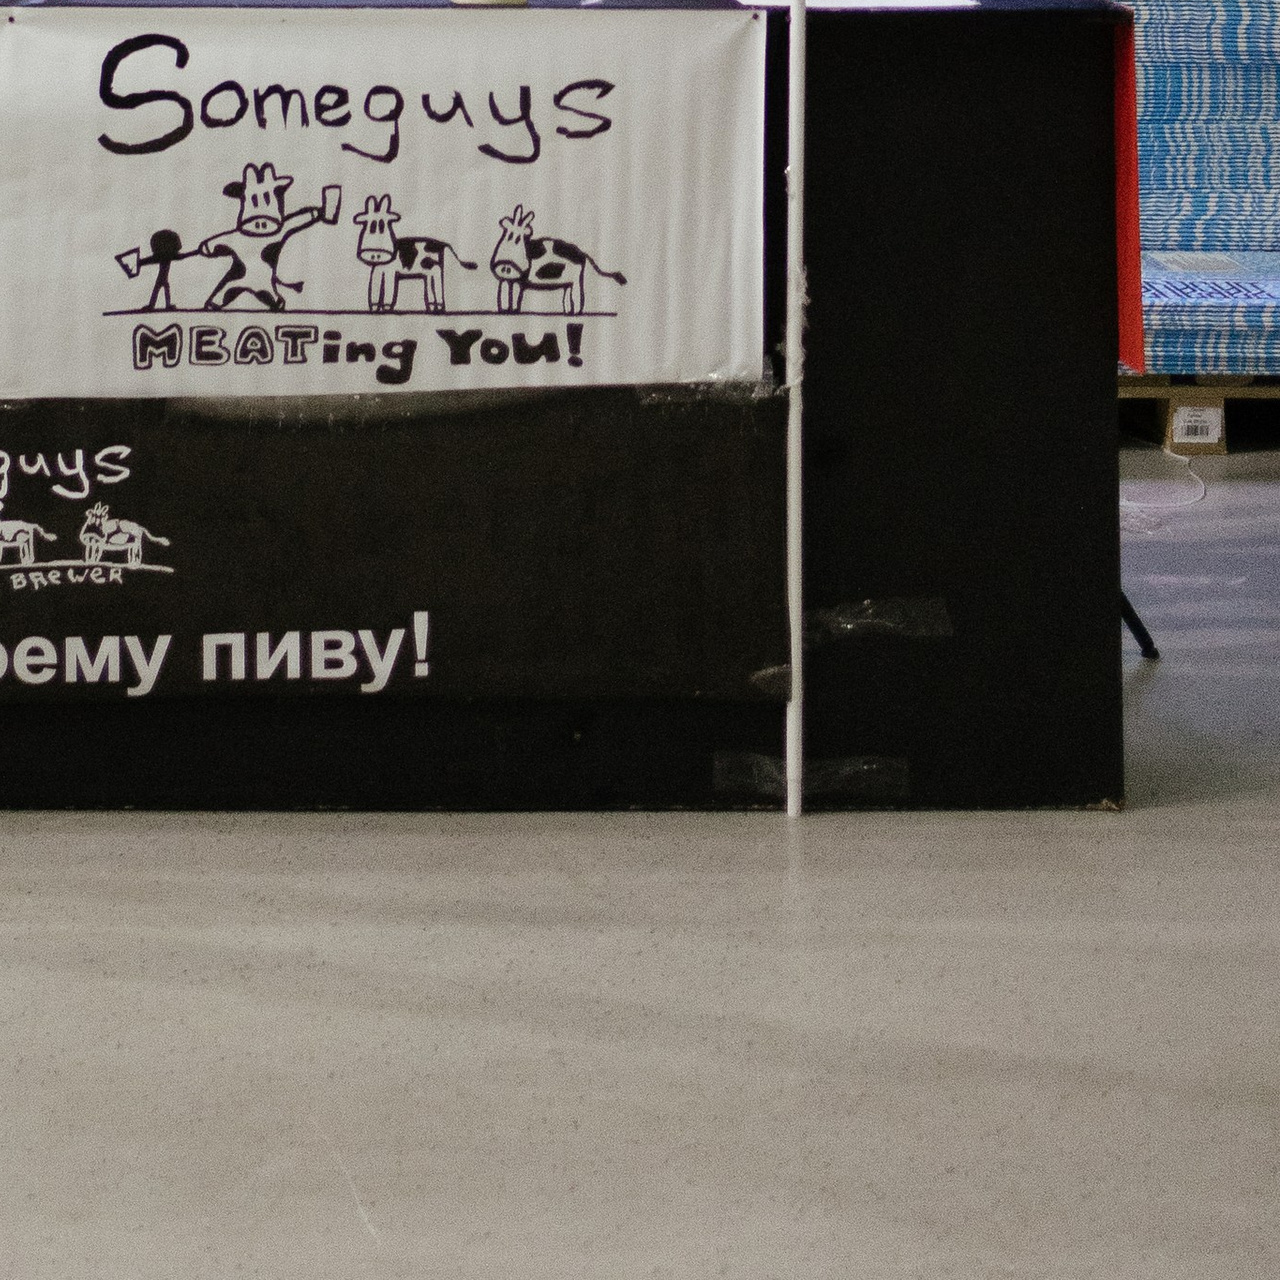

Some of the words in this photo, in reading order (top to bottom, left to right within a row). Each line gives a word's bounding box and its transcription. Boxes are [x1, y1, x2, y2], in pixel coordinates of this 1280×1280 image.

[99, 34, 615, 163] Someguys
[131, 322, 418, 386] MEATing
[202, 610, 429, 693] пиву!
